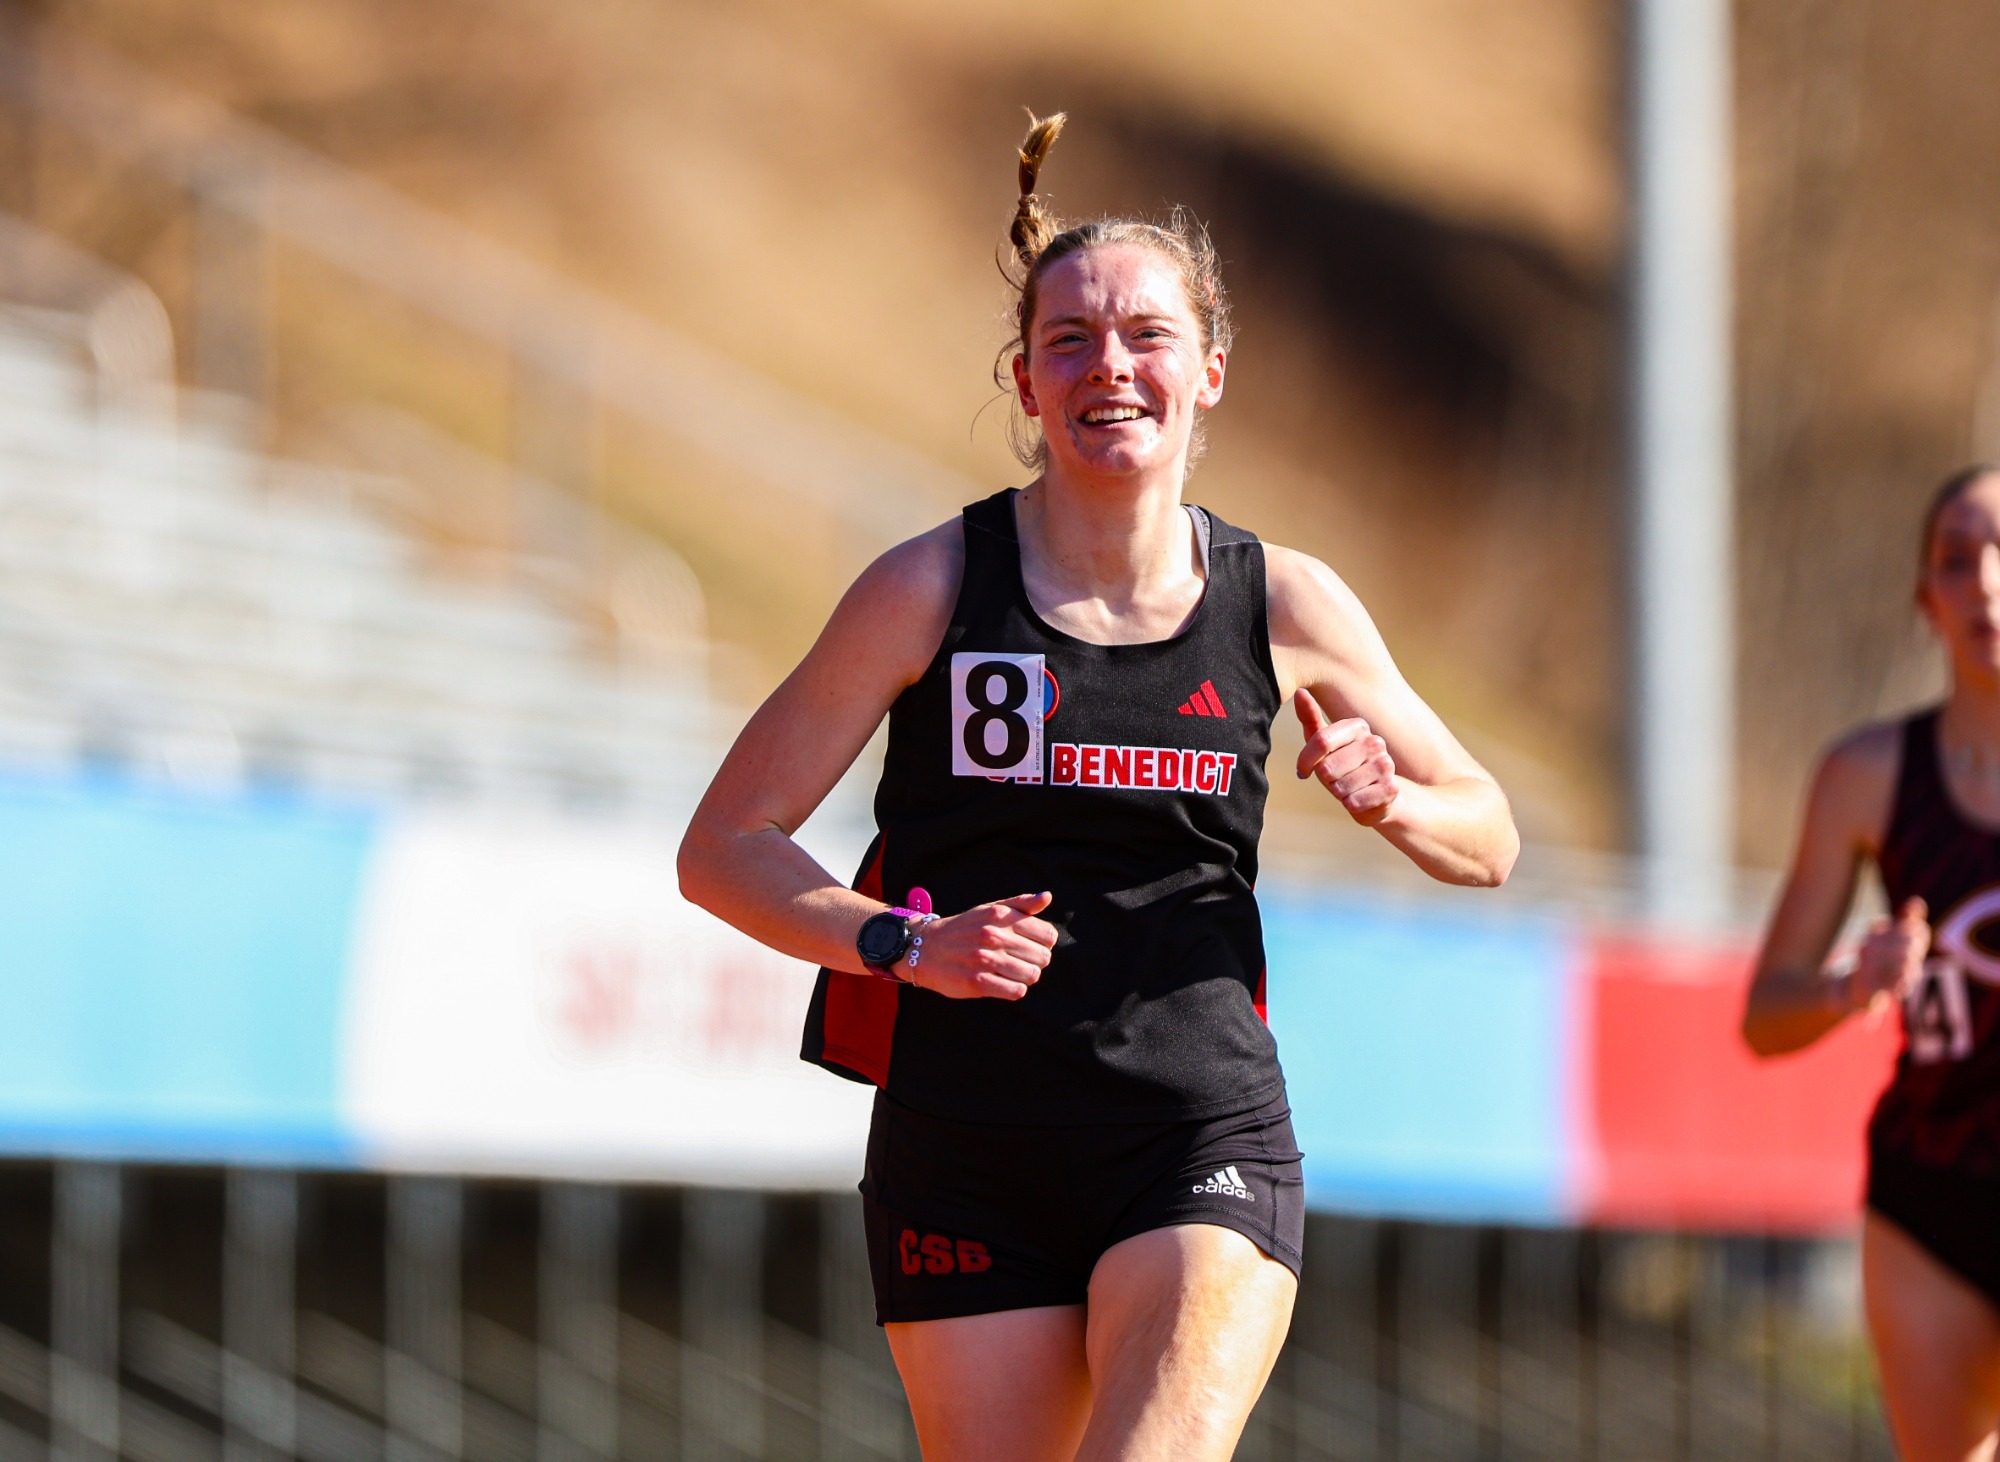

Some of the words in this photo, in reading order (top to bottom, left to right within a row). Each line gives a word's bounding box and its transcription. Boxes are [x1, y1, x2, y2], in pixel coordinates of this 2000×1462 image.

[963, 660, 1030, 770] 8
[1050, 742, 1238, 797] BENEDICT
[899, 1229, 992, 1275] CSB
